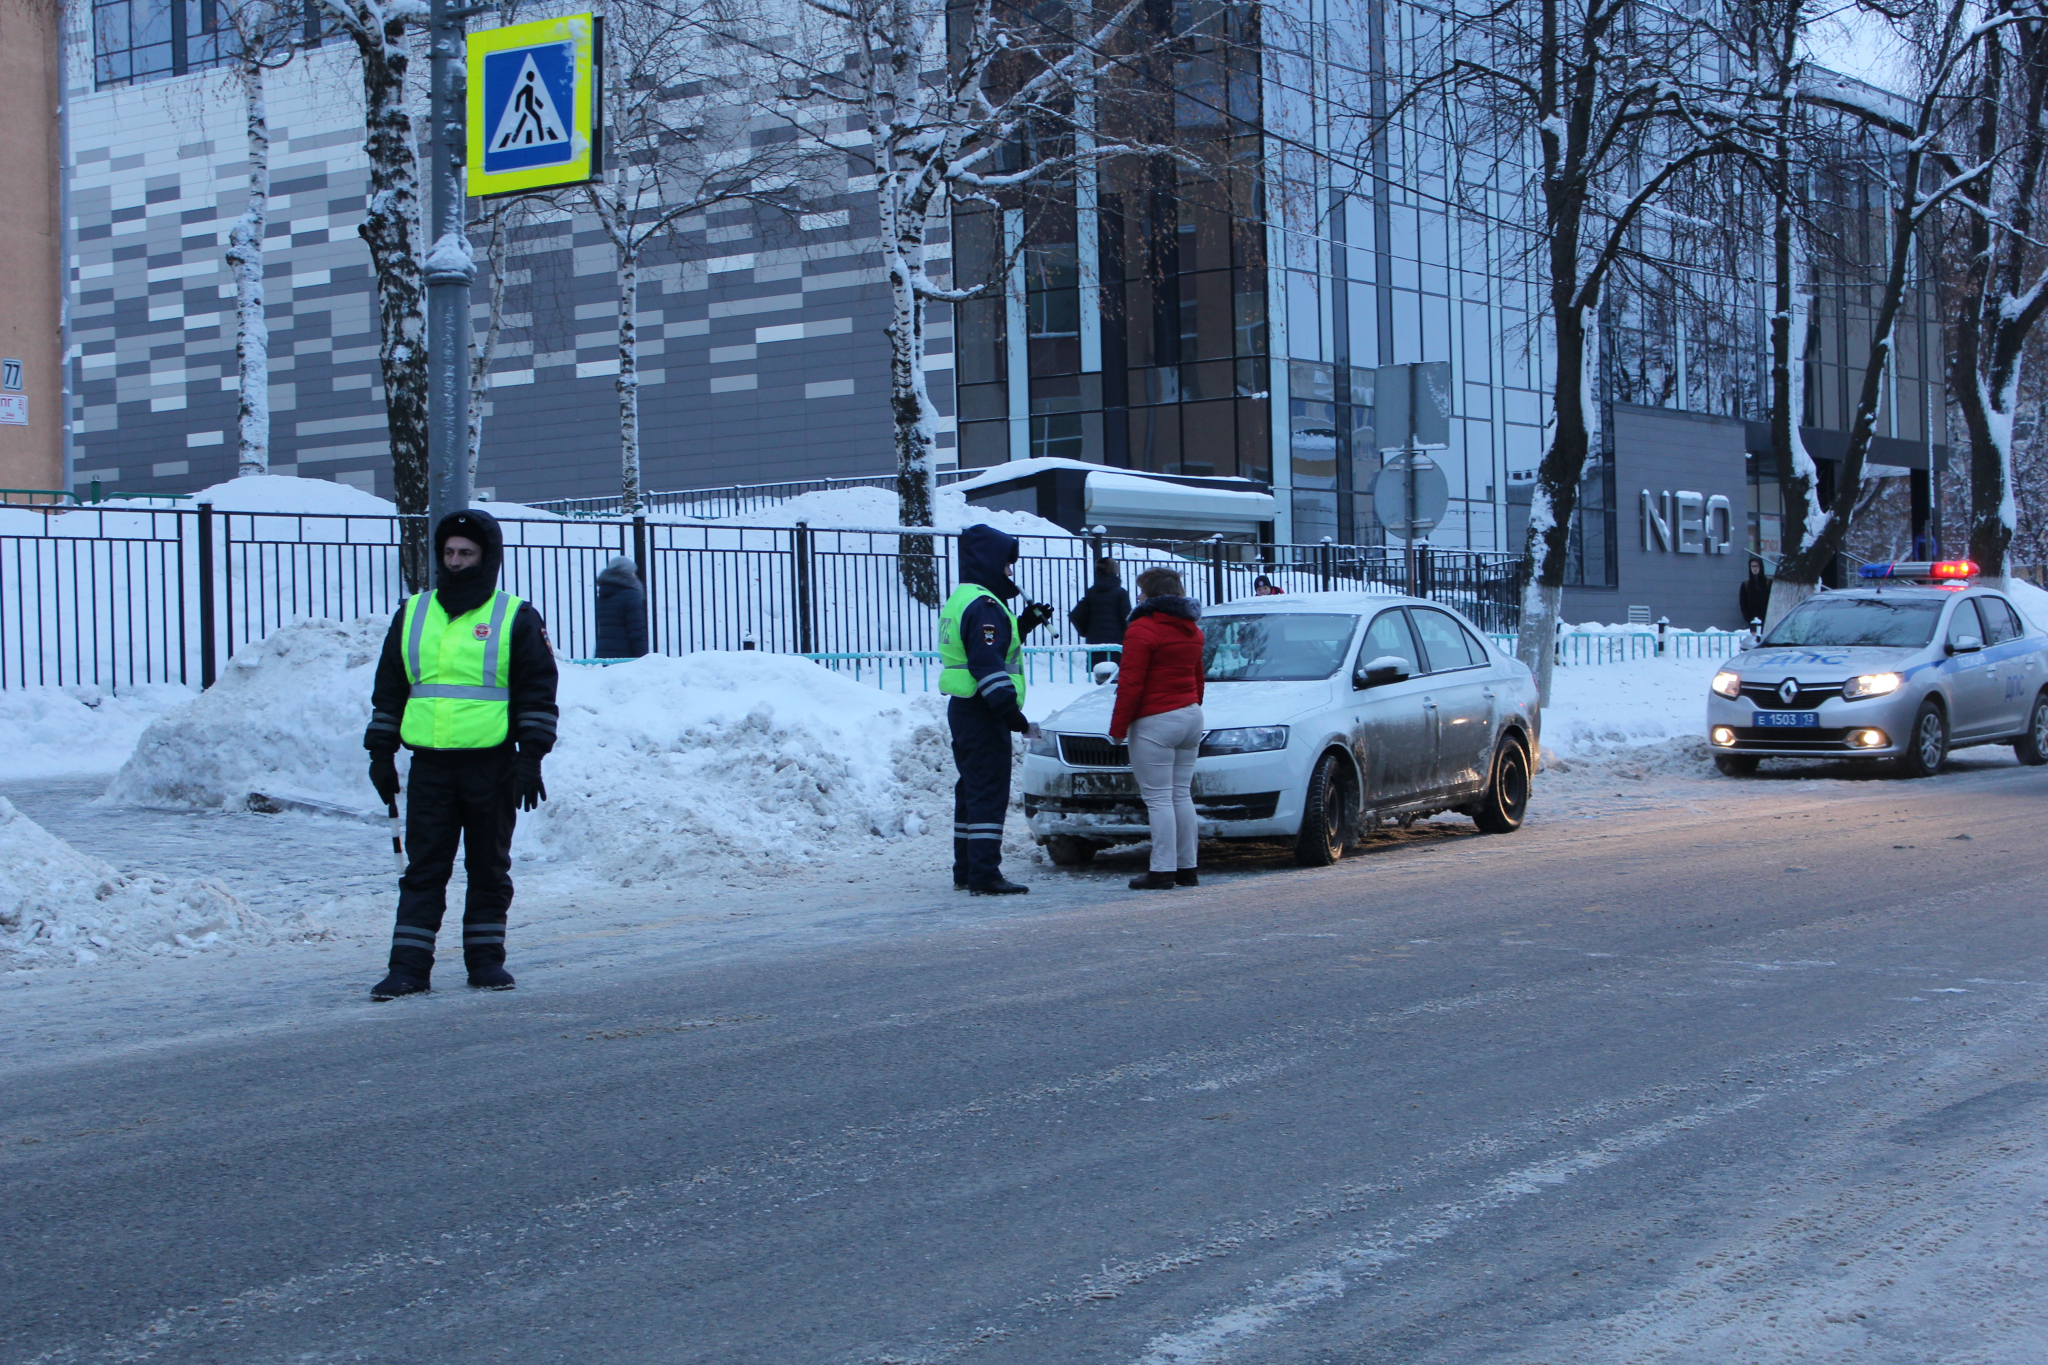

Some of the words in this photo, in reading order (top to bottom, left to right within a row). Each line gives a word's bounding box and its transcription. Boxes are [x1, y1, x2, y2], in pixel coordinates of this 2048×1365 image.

[5, 364, 20, 386] 77
[1640, 488, 1733, 555] NEO
[1758, 654, 1850, 668] ДПС
[2005, 674, 2025, 703] ДПС
[1769, 713, 1797, 725] 1503
[1803, 713, 1814, 723] 13
